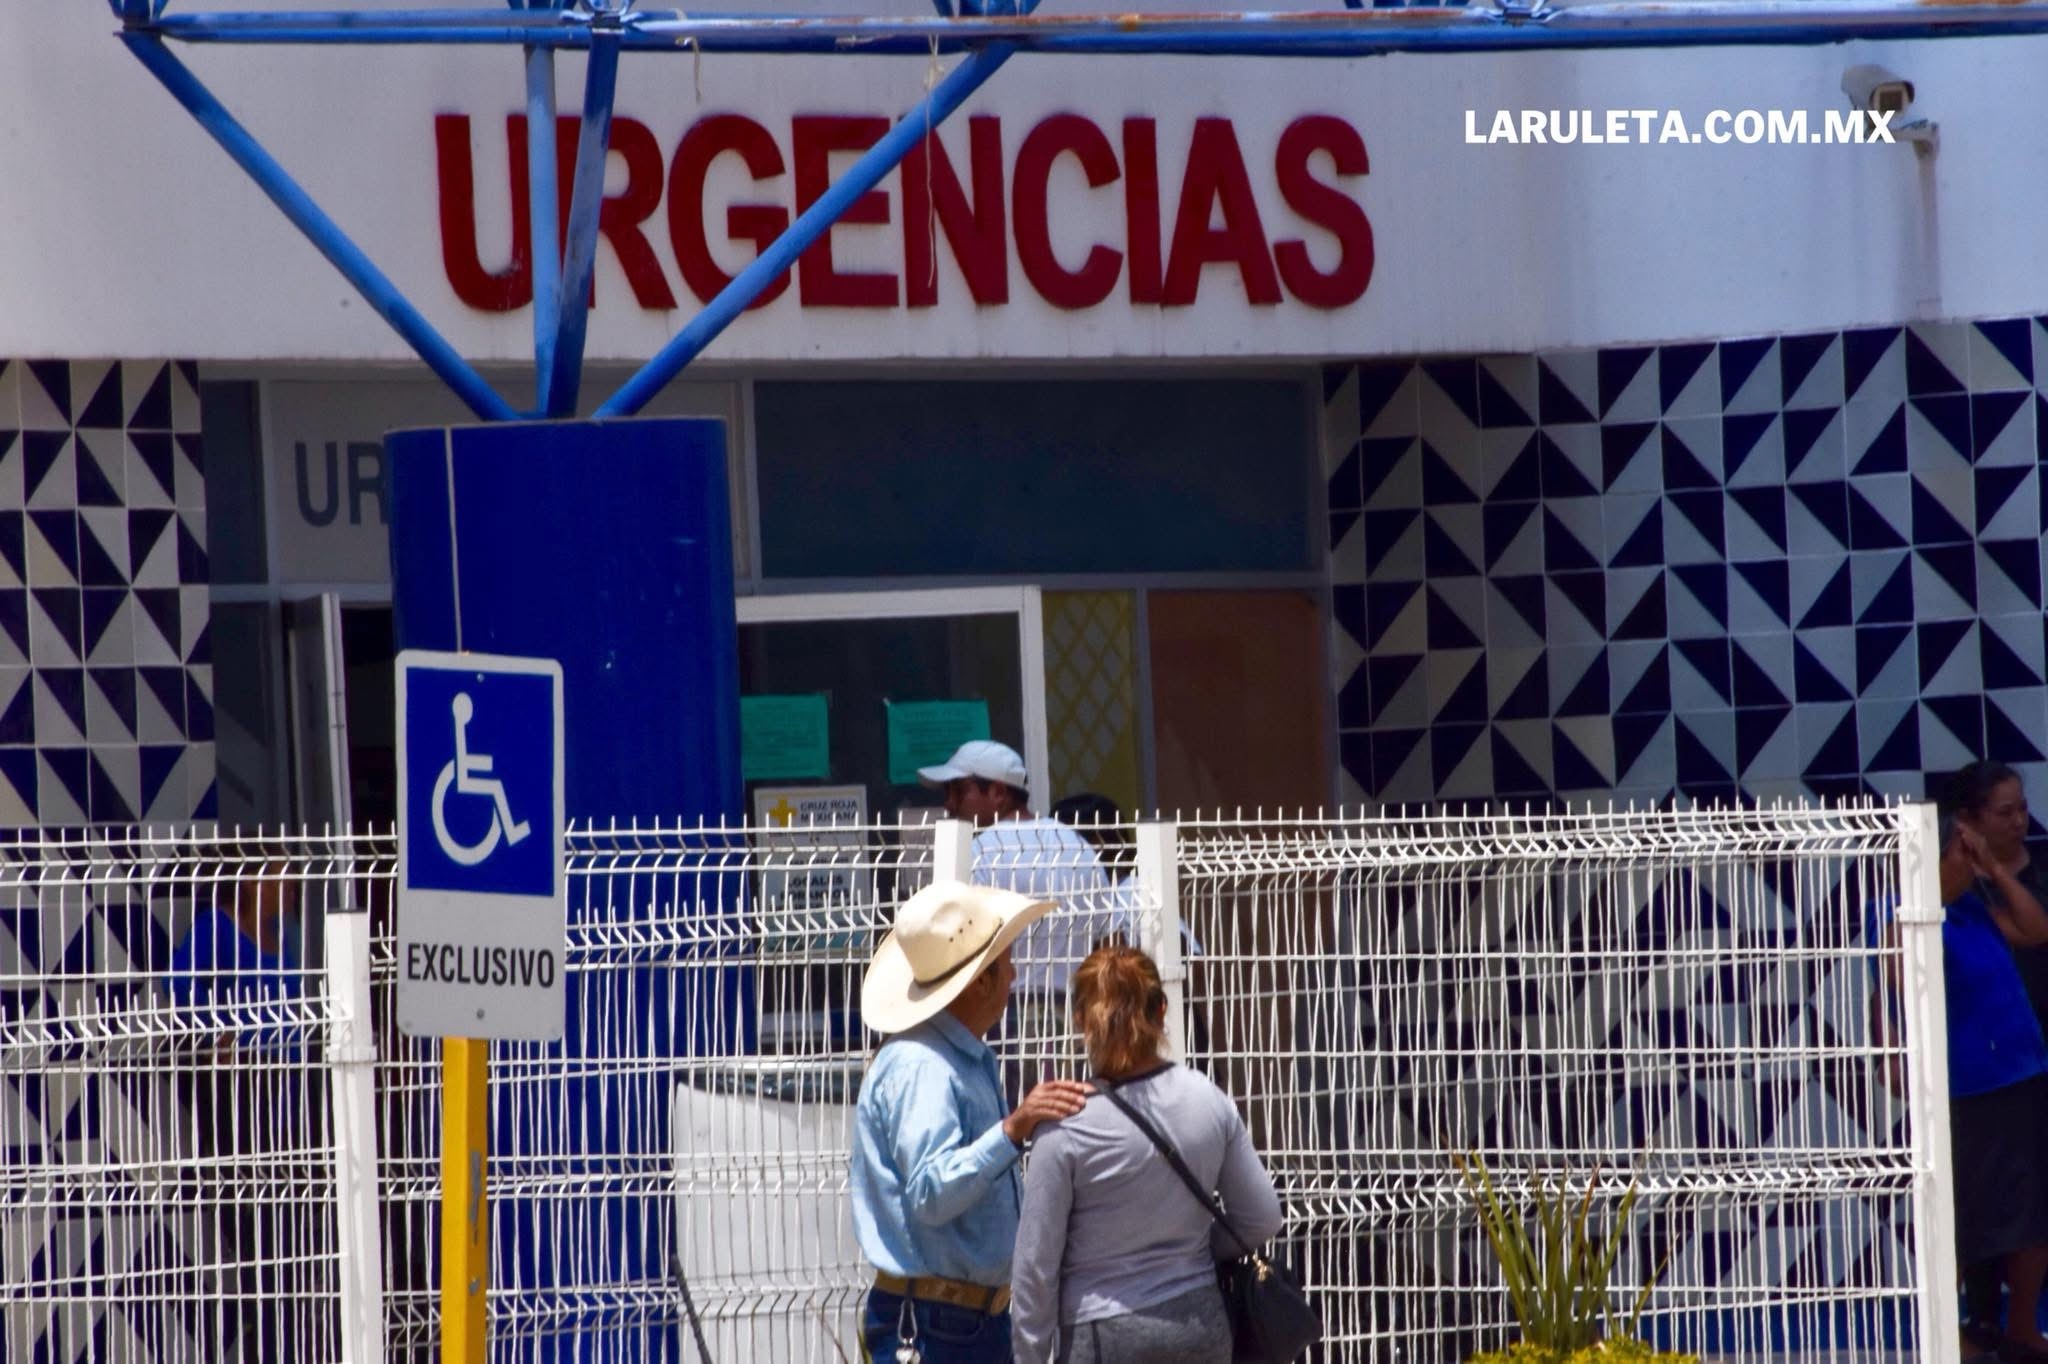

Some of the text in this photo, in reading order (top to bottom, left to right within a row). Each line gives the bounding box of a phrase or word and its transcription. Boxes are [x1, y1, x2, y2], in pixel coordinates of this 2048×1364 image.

[434, 112, 1376, 311] URGENCIAS
[800, 798, 858, 811] CRUZ ROJA
[800, 810, 858, 822] MXICANA
[407, 942, 555, 988] EXCLUSIVO
